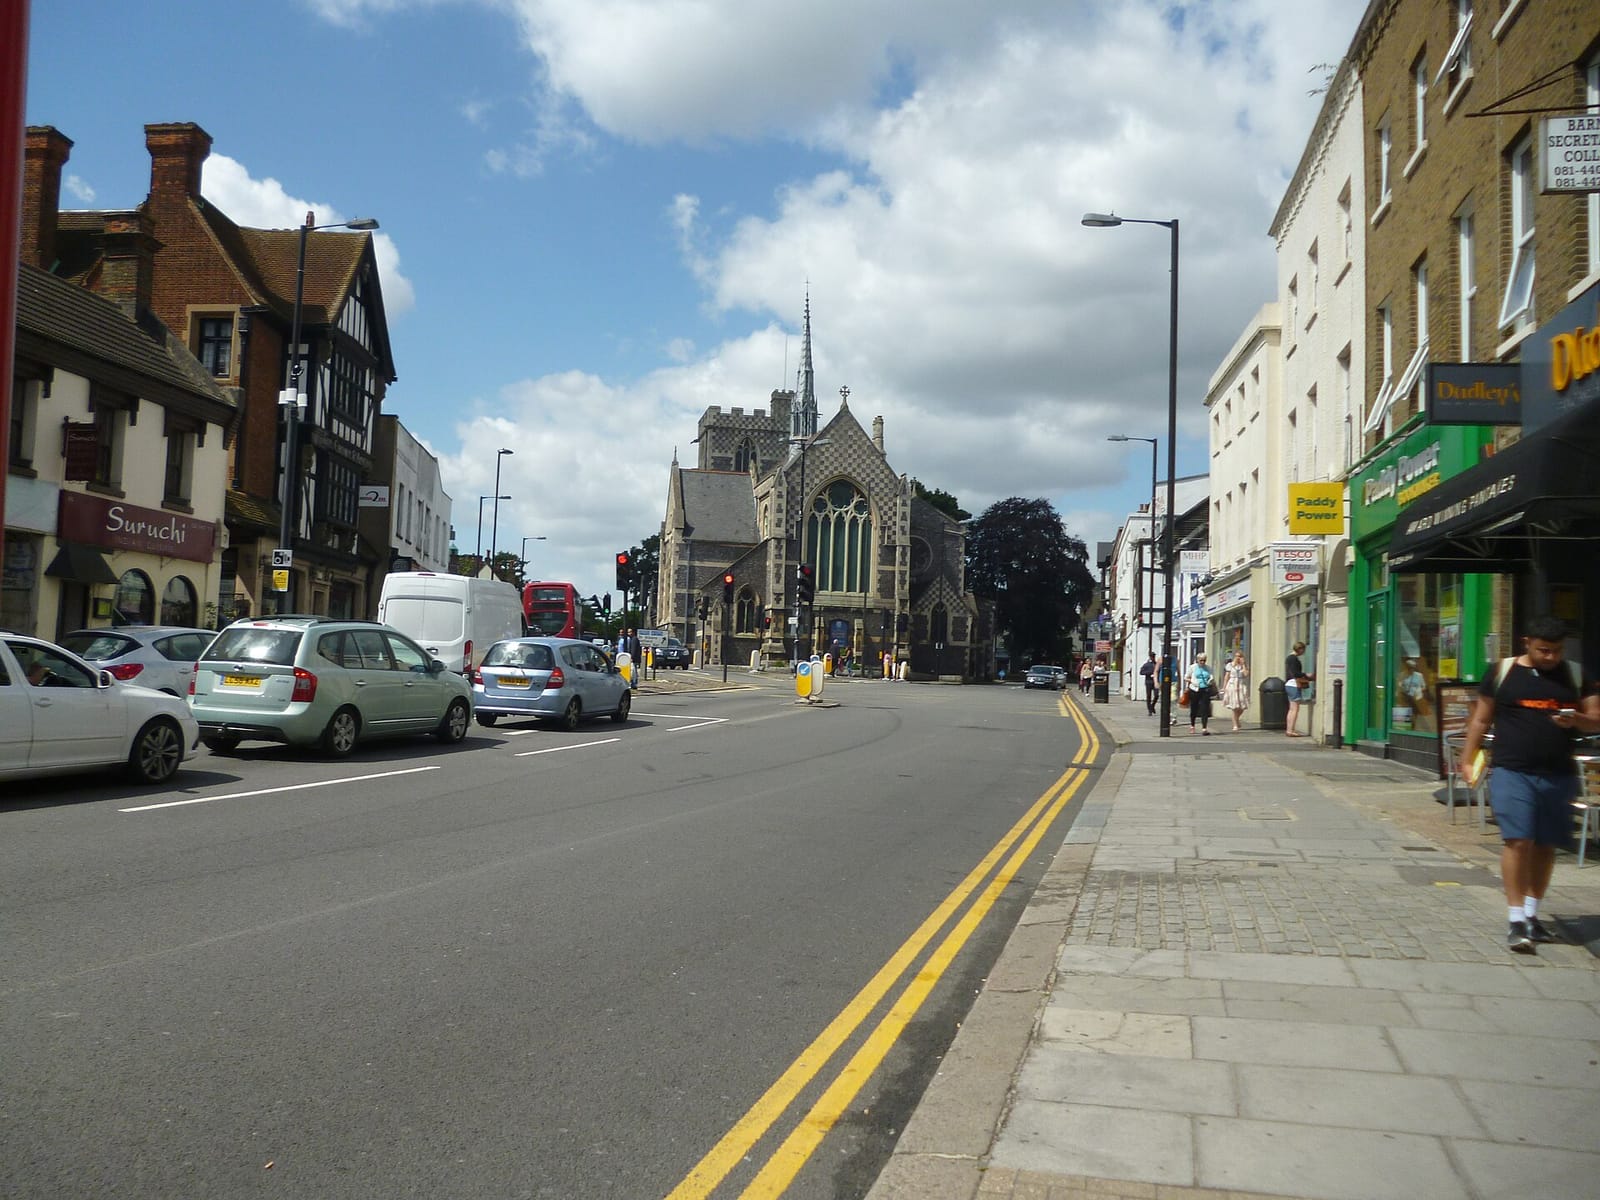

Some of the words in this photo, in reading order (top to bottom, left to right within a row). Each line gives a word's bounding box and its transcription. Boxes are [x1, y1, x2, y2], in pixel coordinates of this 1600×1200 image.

[1549, 134, 1600, 147] SECRET
[1296, 497, 1337, 508] Paddy
[1296, 511, 1338, 520] Power
[105, 506, 186, 544] Suruchi
[1276, 550, 1313, 559] TESCO
